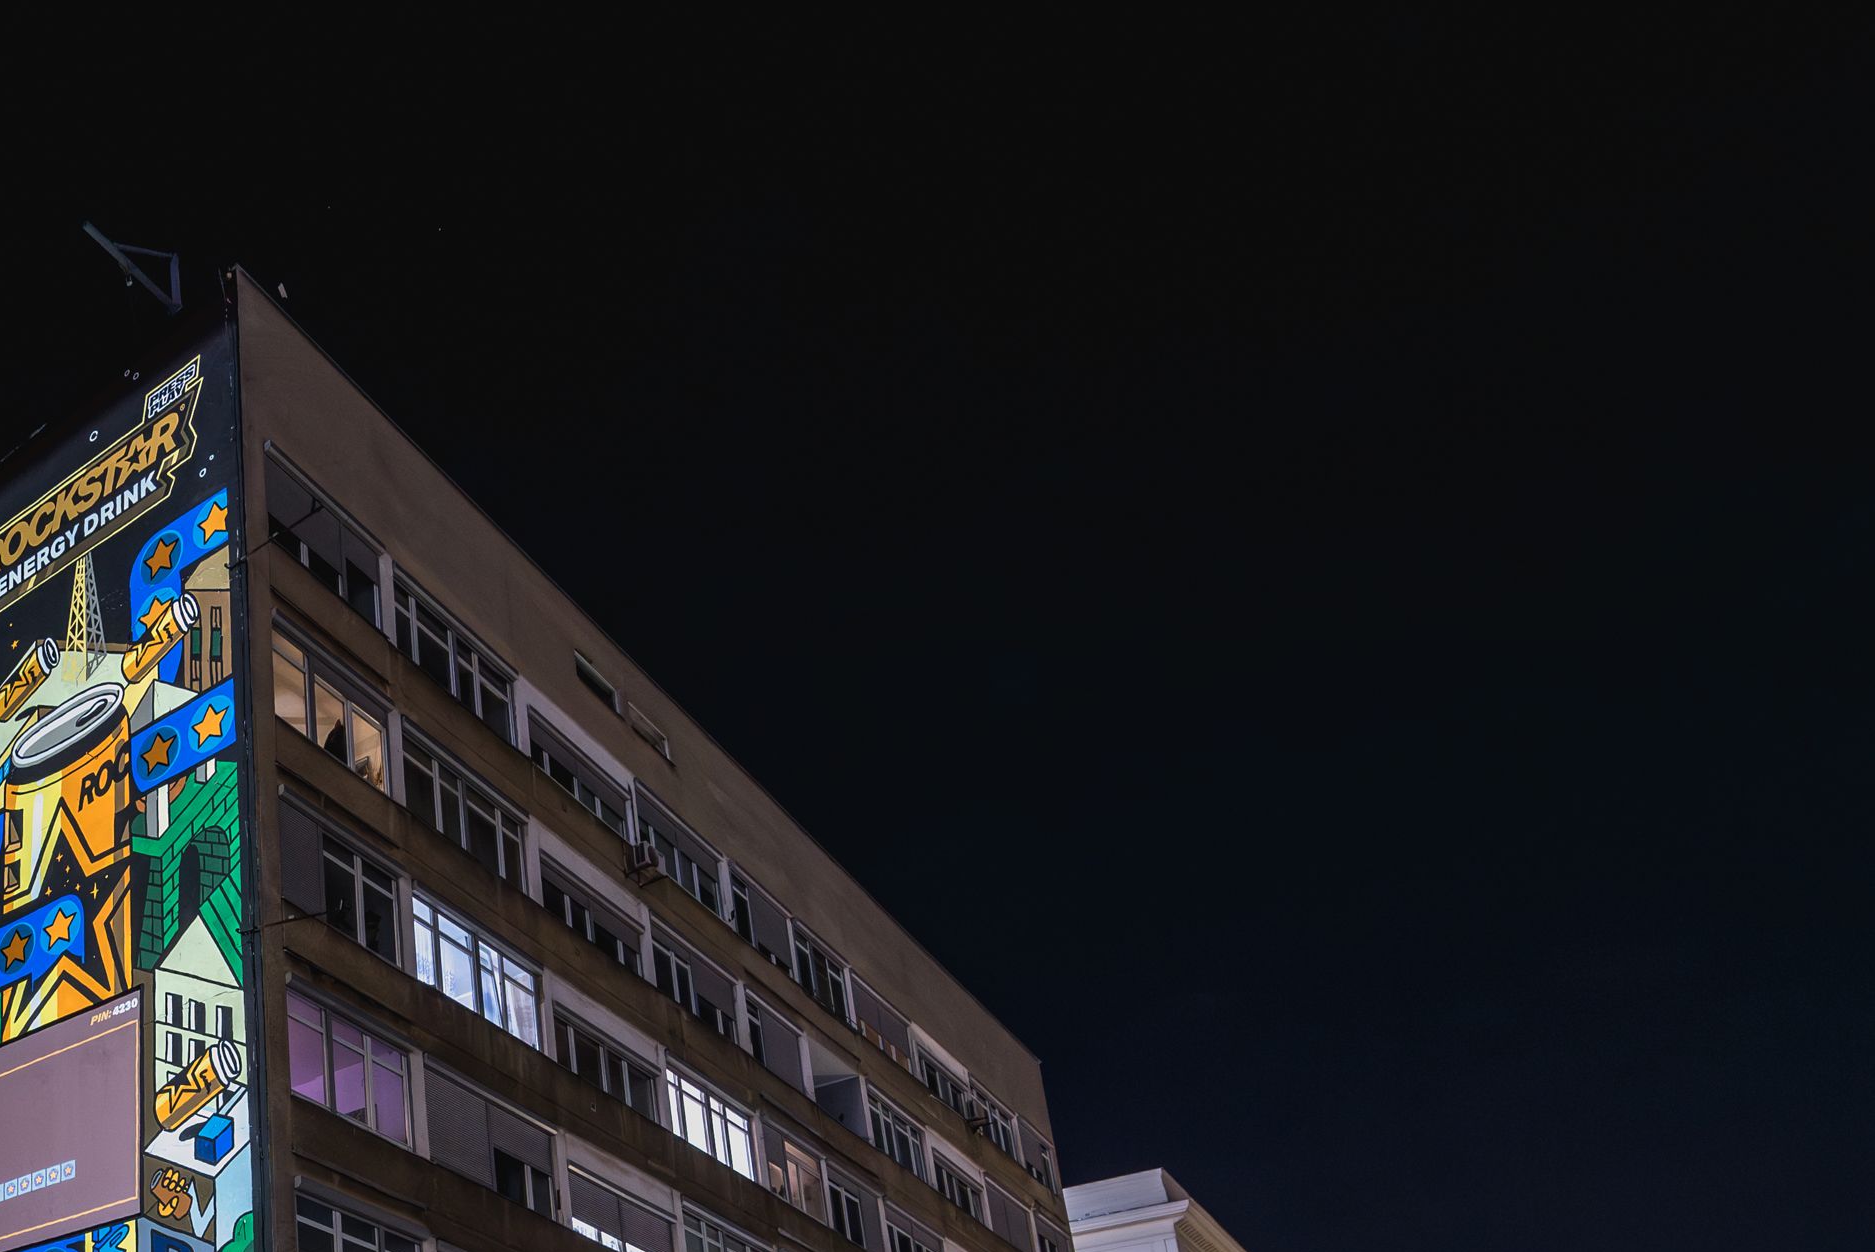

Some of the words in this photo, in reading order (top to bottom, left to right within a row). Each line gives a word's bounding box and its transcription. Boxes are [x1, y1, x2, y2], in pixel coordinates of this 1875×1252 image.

[149, 364, 195, 408] PRESS
[84, 470, 158, 537] DRINK
[90, 1010, 112, 1026] PIN:
[112, 997, 138, 1016] 4230
